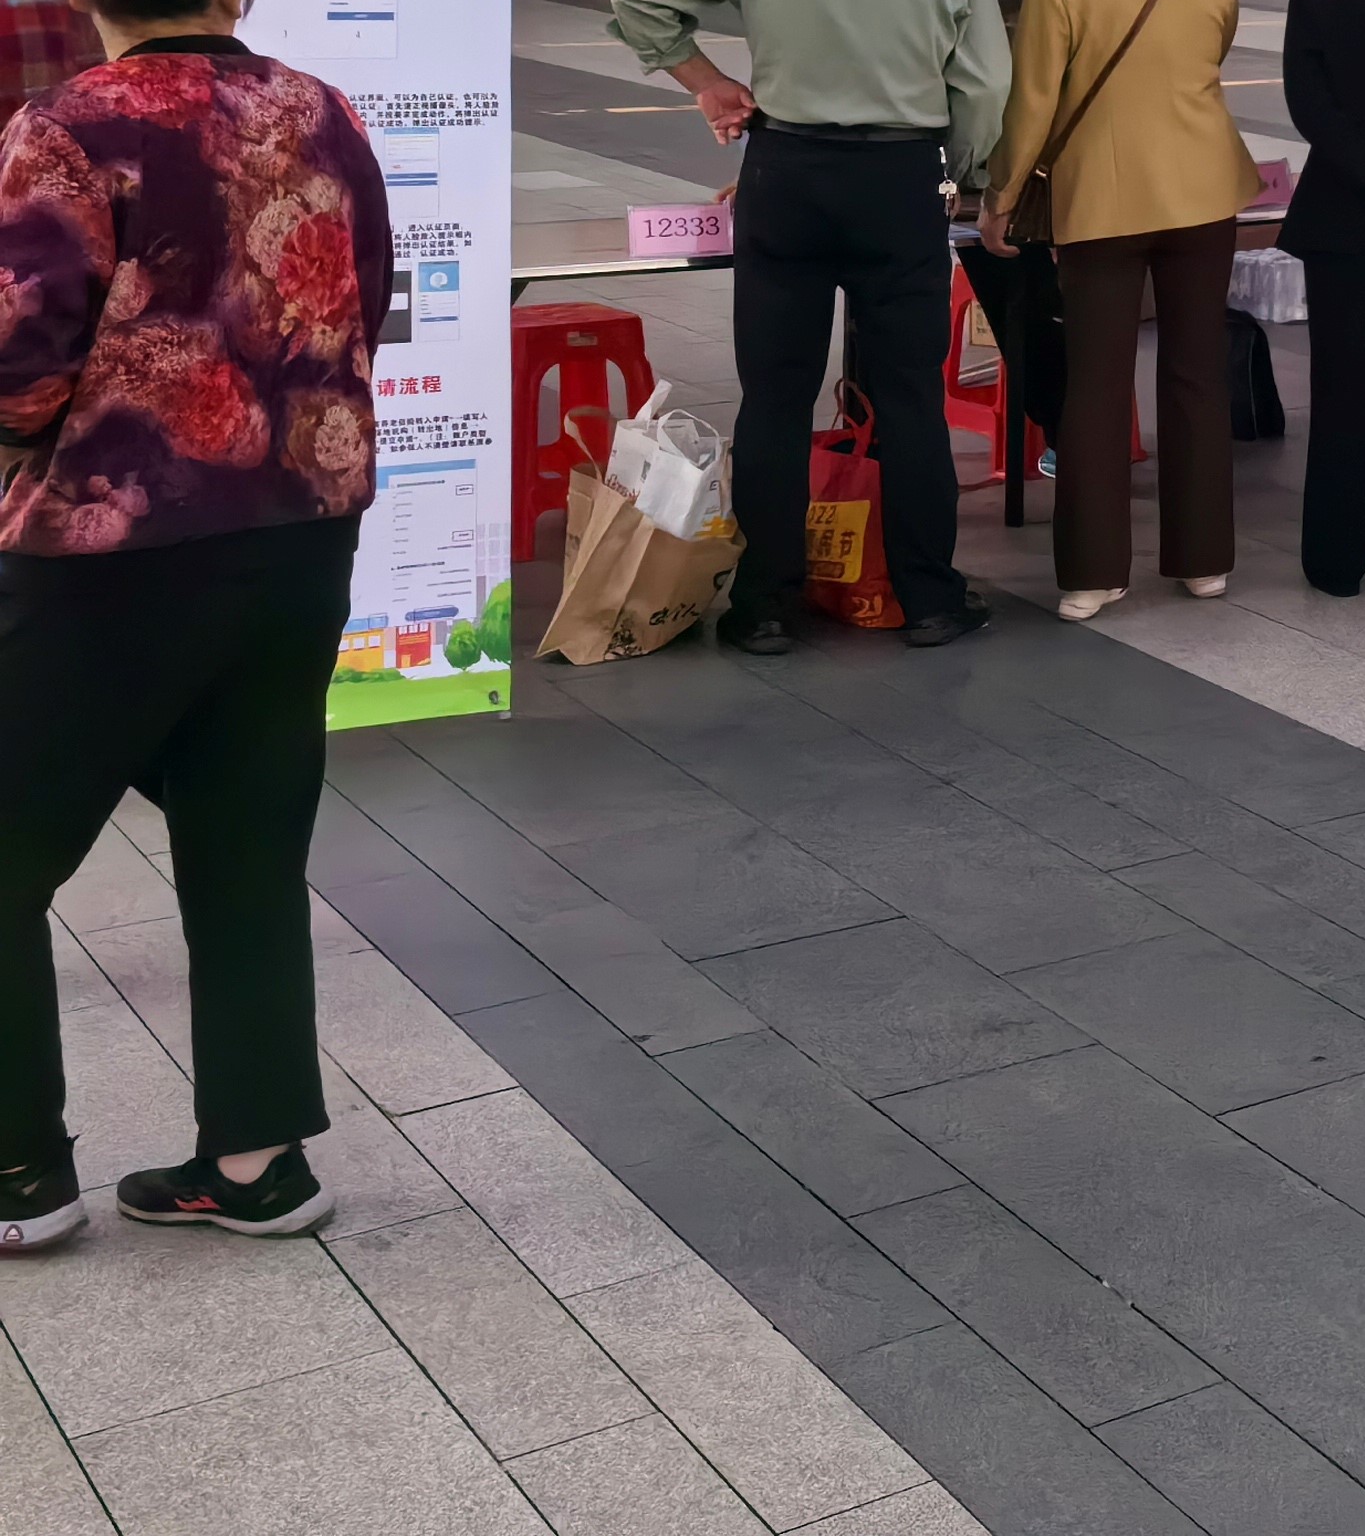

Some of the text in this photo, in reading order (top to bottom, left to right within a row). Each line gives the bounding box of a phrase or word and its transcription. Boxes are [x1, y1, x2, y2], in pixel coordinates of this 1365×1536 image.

[642, 216, 721, 239] 12333
[376, 375, 443, 398] 请流程
